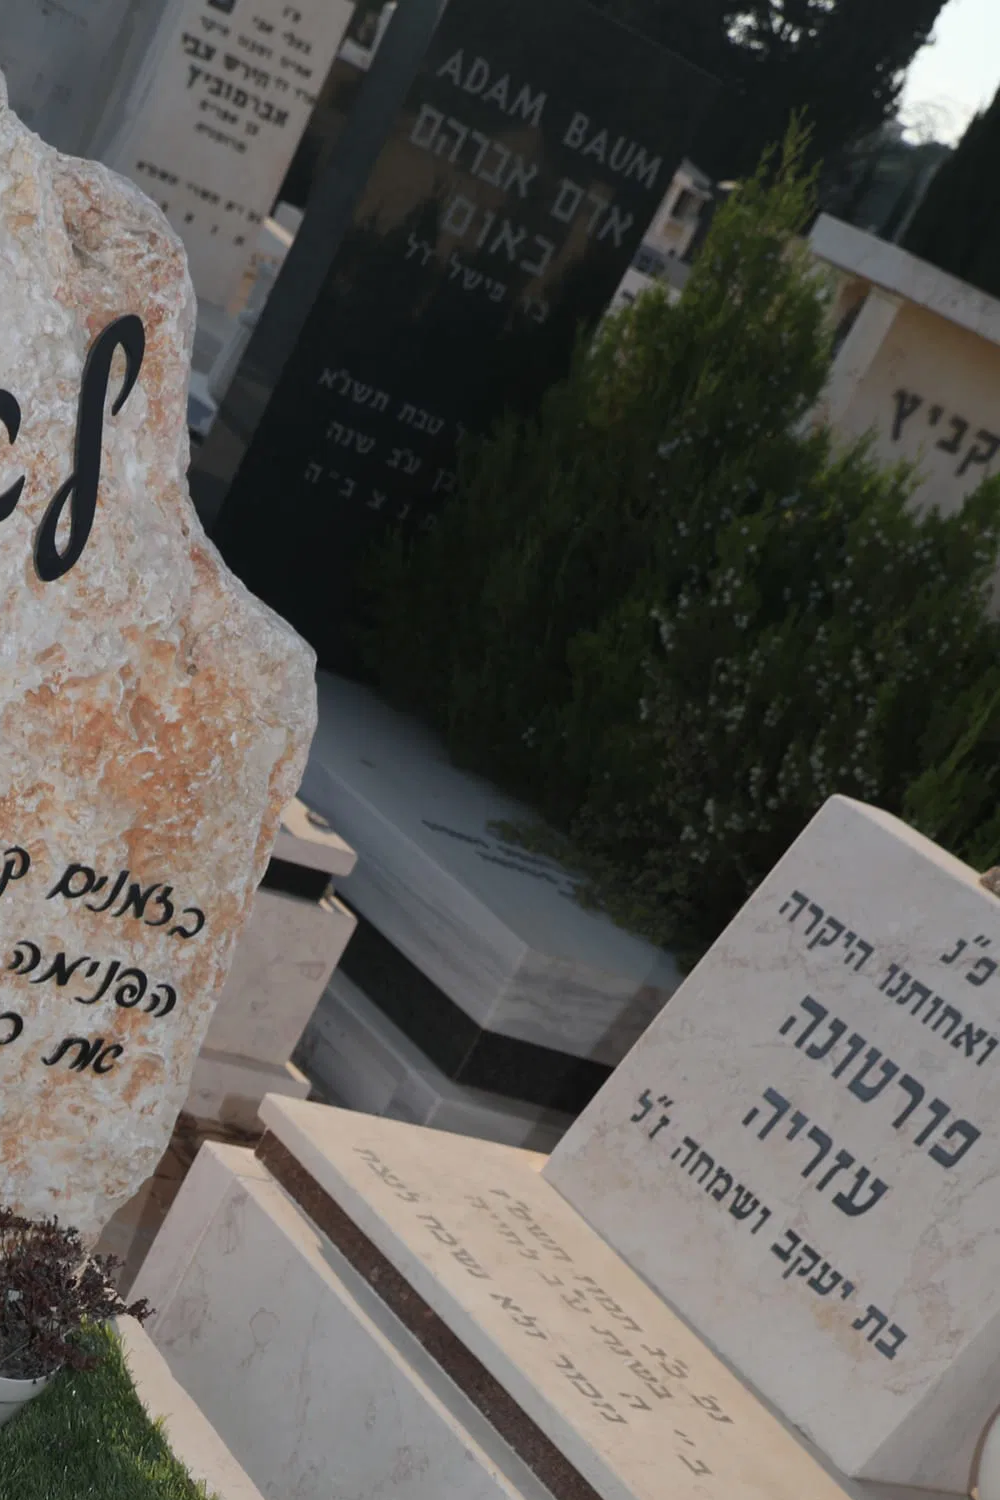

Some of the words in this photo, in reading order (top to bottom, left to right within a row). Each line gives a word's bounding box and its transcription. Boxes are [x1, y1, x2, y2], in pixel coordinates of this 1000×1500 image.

[186, 64, 290, 128] אברמוביץ
[436, 48, 548, 128] ADAM
[561, 111, 664, 190] BAUM
[408, 102, 539, 199] אברהם
[440, 194, 557, 278] באום
[549, 176, 635, 248] אדם
[45, 862, 206, 940] בזמנים
[778, 890, 875, 972] היקרה
[7, 940, 177, 1018] הפנימה
[939, 934, 998, 987] פ"נ
[878, 963, 999, 1067] ואחותנו
[41, 1037, 124, 1074] את
[778, 995, 982, 1169] פורטונה
[629, 1088, 674, 1139] ז"ל
[741, 1087, 889, 1217] עזריה
[671, 1135, 773, 1235] ושמחה
[769, 1228, 856, 1301] יעקב
[851, 1304, 908, 1361] בת
